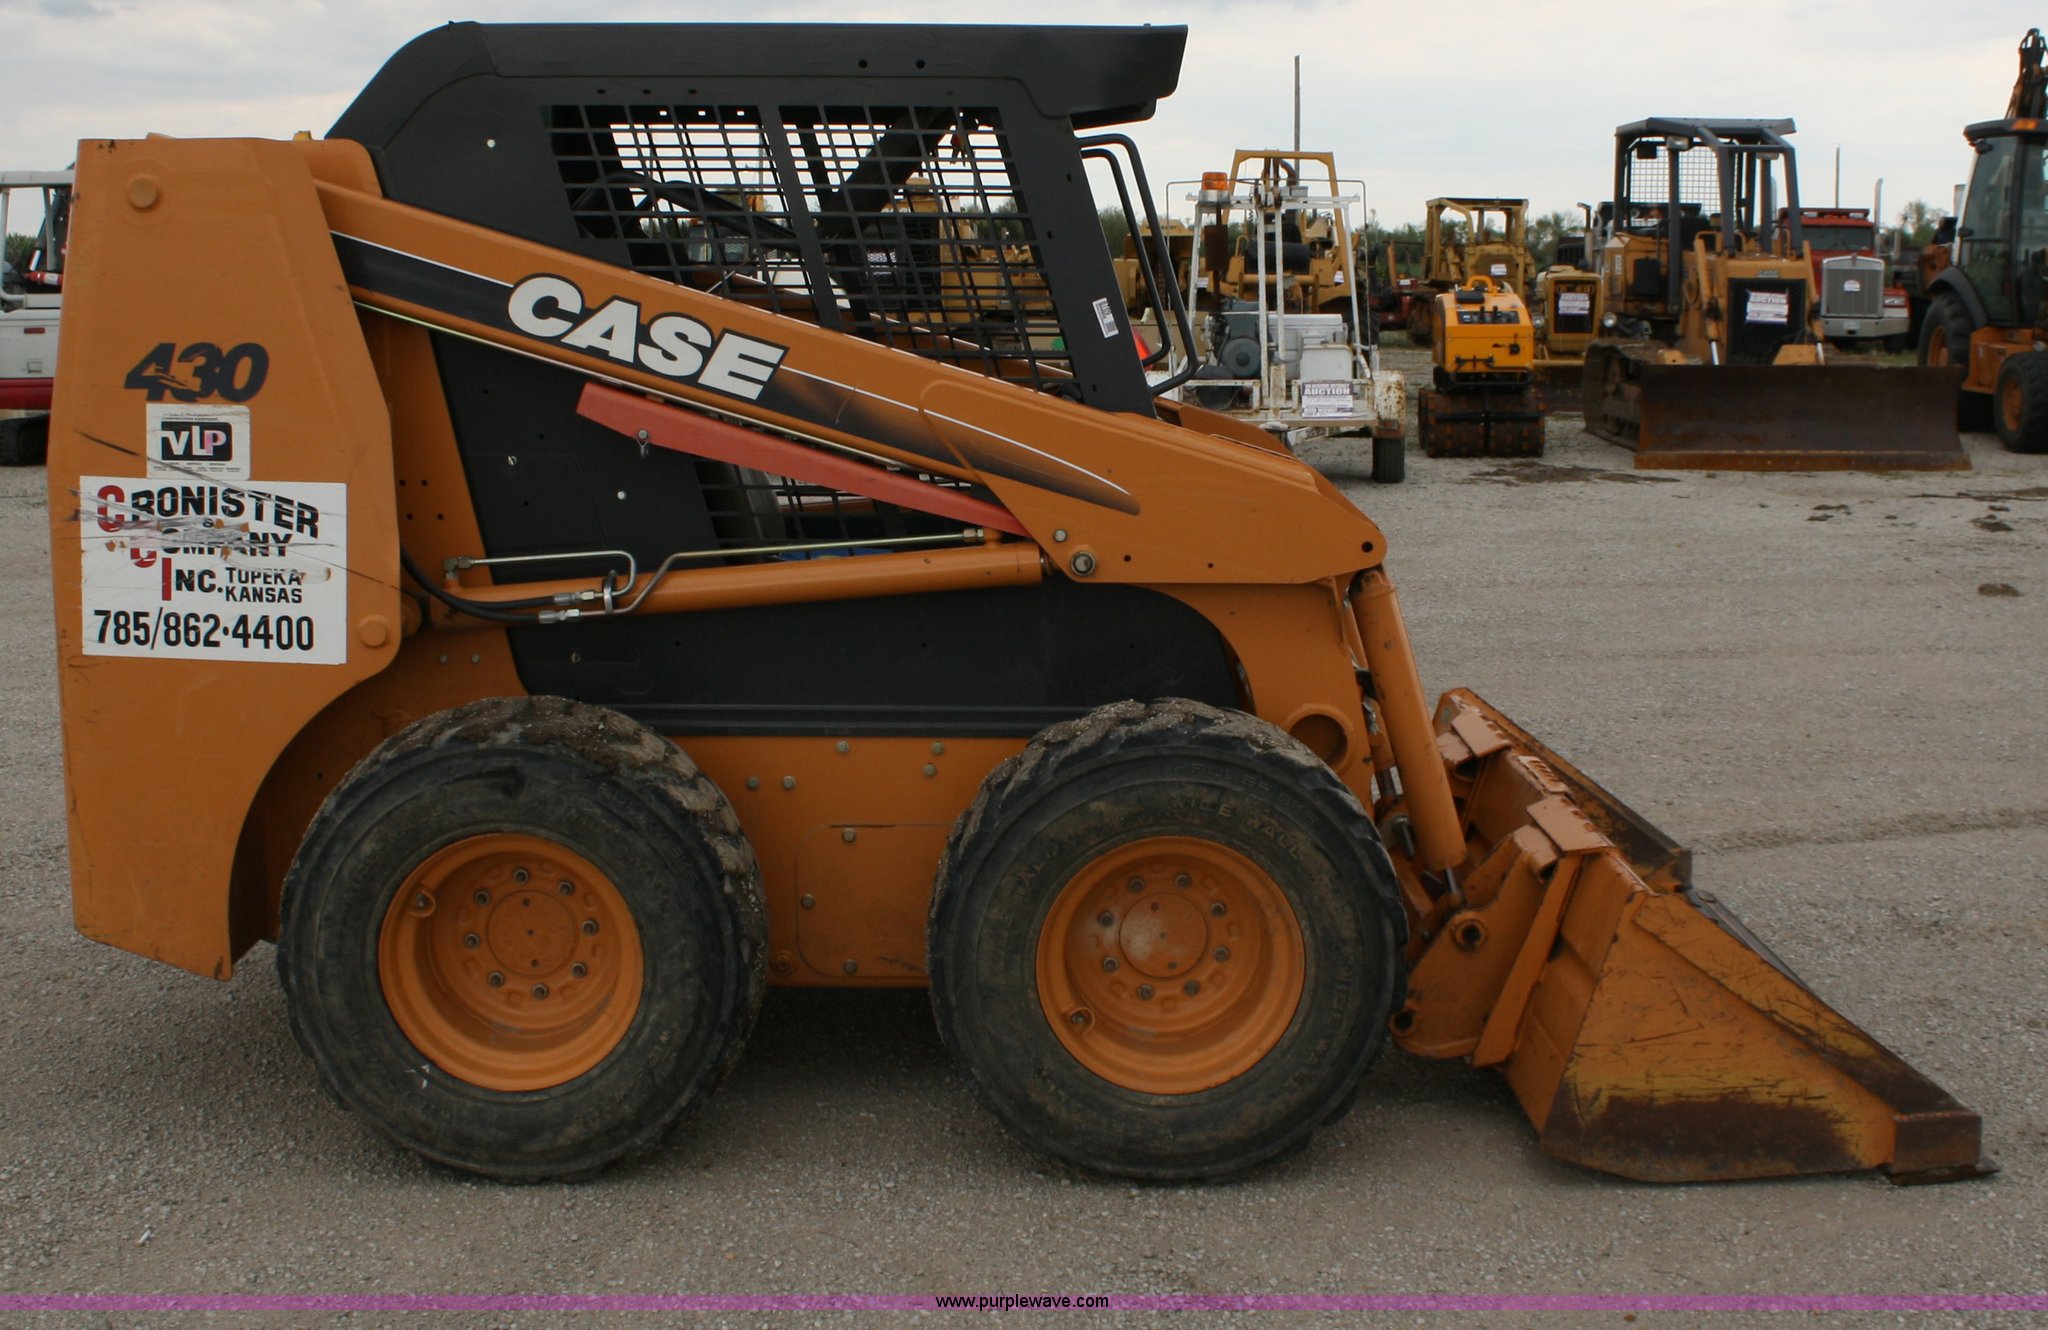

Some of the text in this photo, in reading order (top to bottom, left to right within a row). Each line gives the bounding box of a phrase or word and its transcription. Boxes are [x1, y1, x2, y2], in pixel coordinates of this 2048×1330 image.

[508, 275, 786, 400] CASE
[124, 342, 270, 402] 430
[97, 485, 319, 539] CRONISTER
[225, 586, 302, 604] KANSAS
